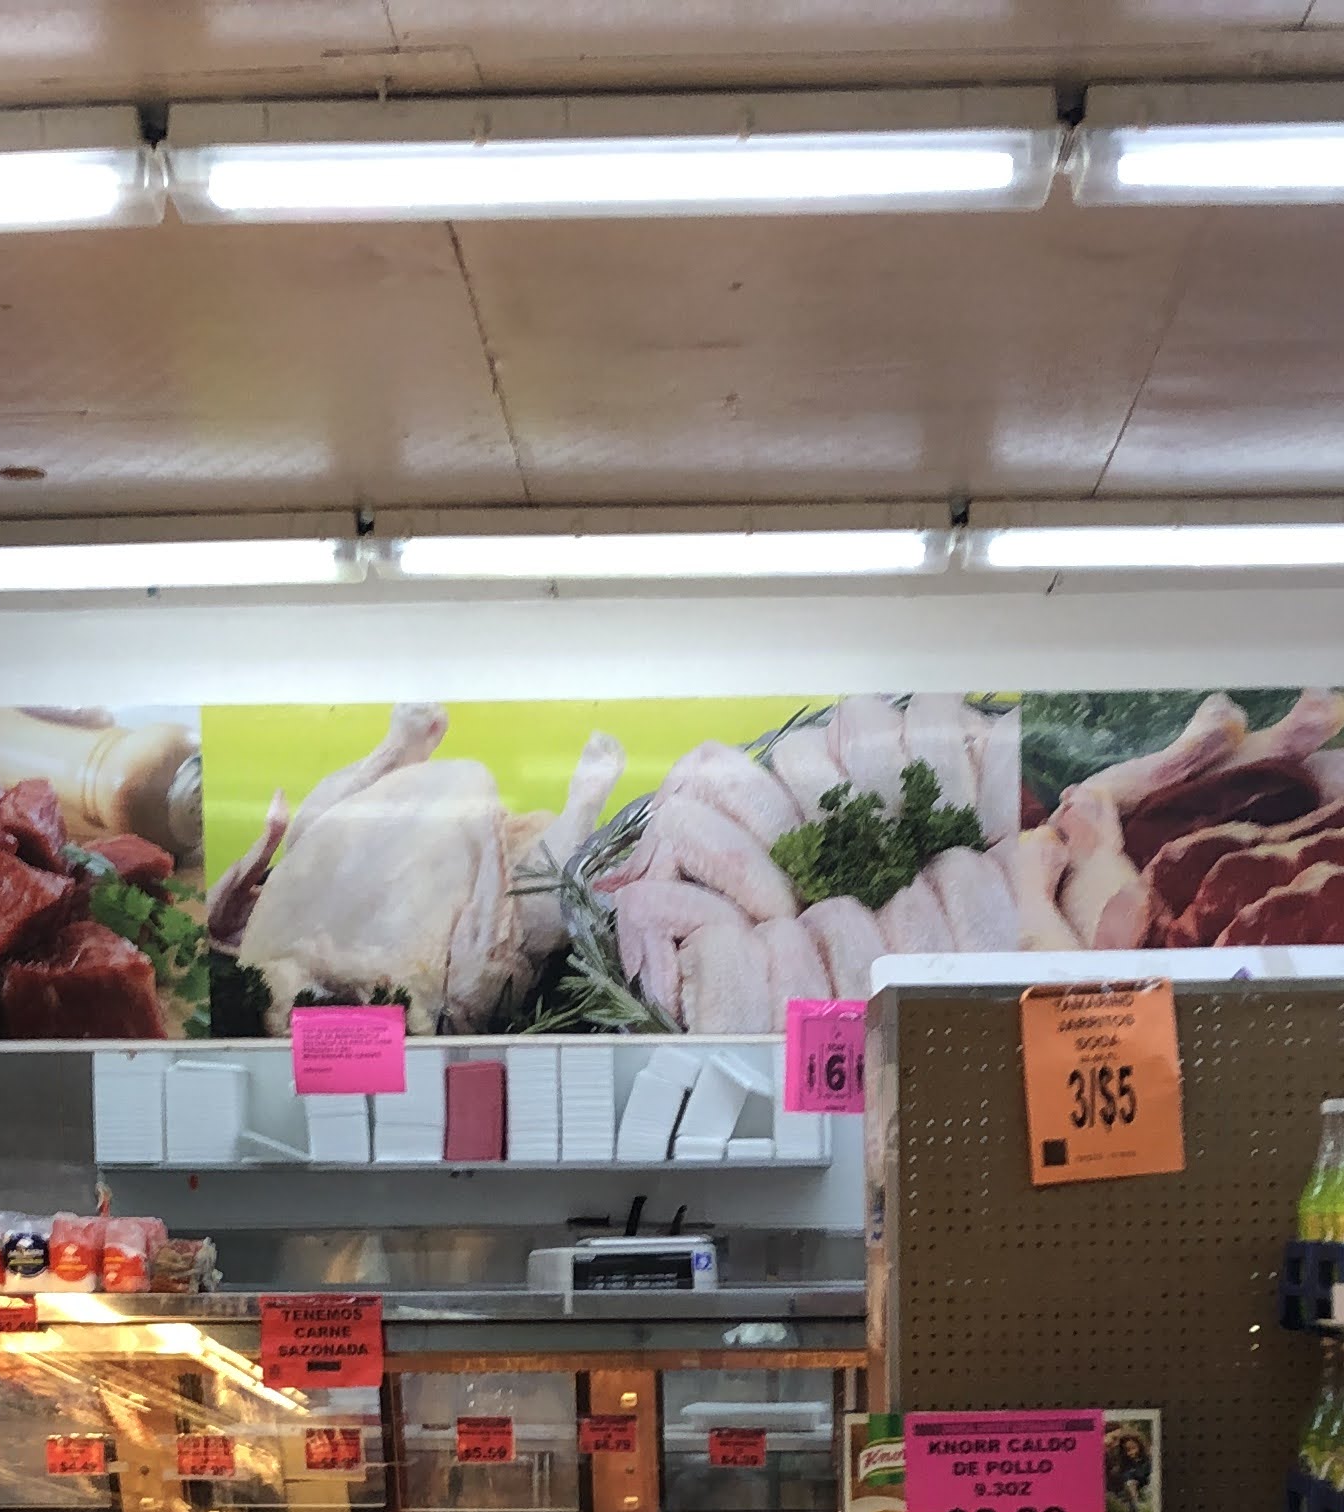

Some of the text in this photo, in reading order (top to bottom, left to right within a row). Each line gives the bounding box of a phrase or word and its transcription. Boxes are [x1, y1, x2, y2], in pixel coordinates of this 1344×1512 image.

[1067, 1064, 1138, 1134] 3/$5
[281, 1309, 363, 1322] TENEMOS
[293, 1326, 353, 1339] CARNE
[278, 1344, 369, 1358] SAZONADA
[927, 1436, 1077, 1455] KNORR CALDO
[952, 1459, 1054, 1477] DE POLLO
